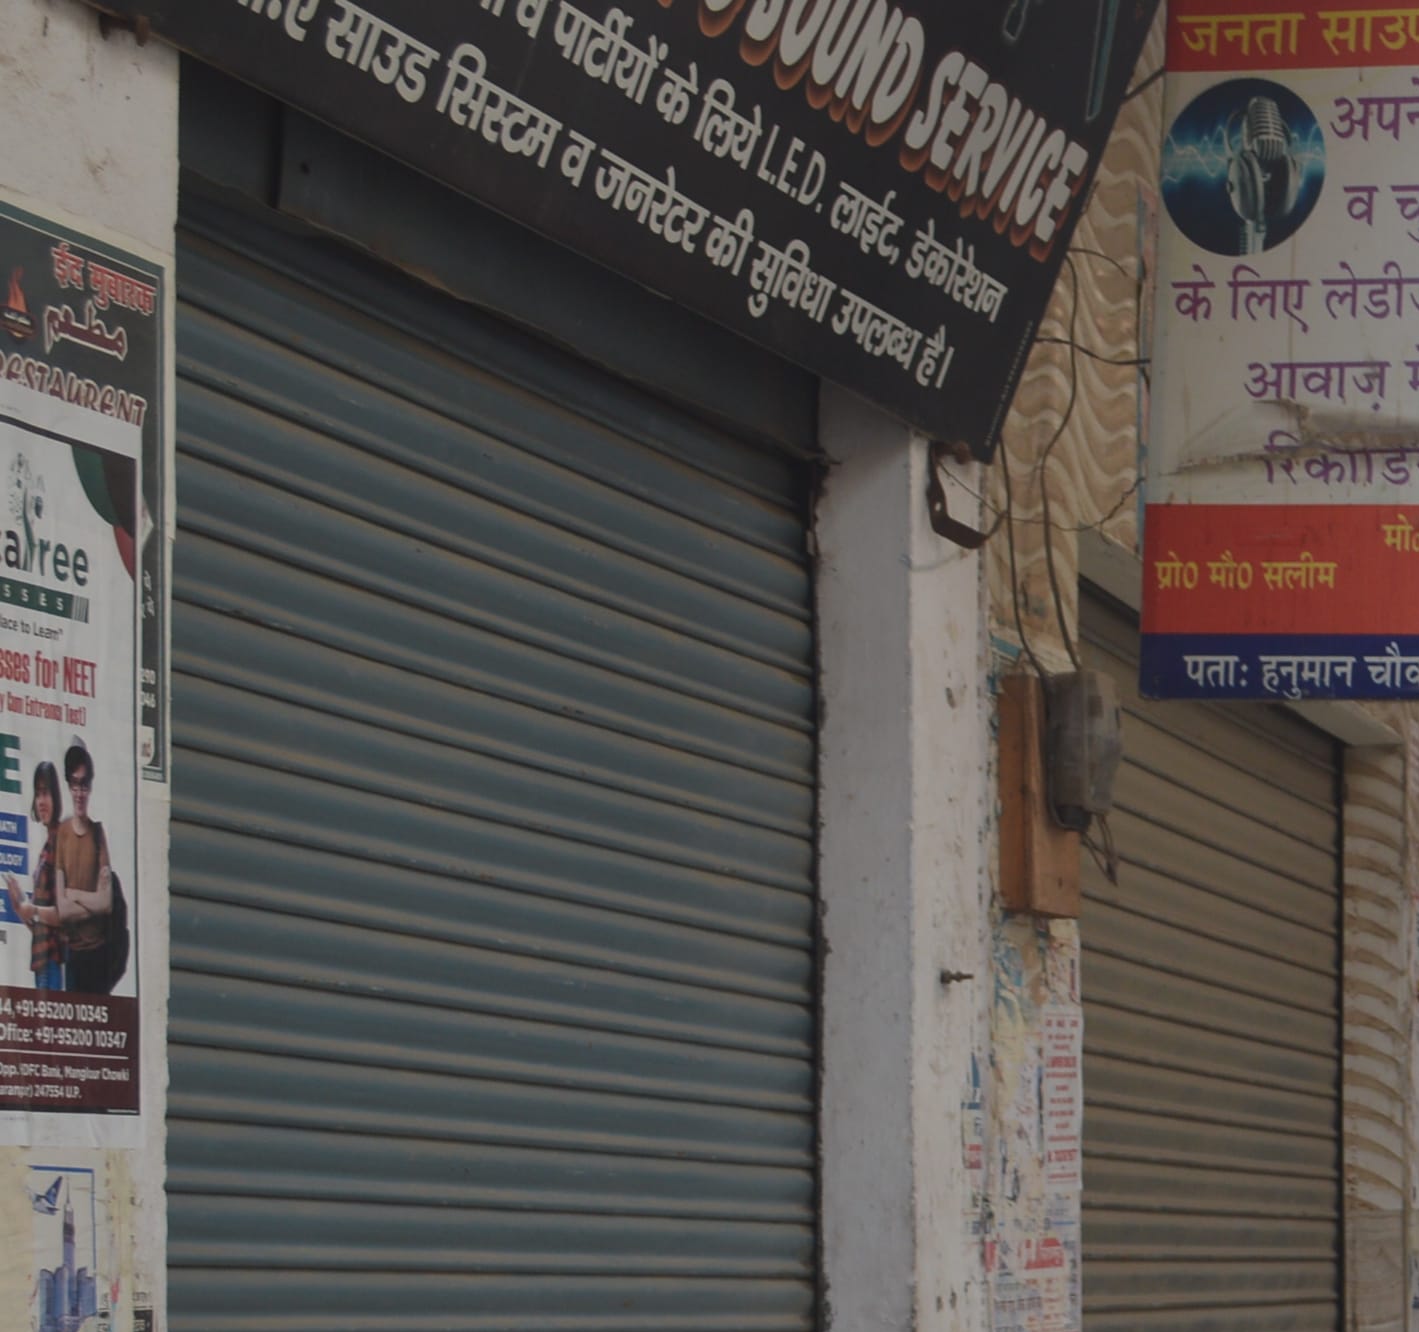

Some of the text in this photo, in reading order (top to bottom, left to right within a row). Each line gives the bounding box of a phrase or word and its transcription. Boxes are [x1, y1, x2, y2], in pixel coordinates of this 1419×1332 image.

[1177, 12, 1306, 57] जनता
[904, 50, 1090, 262] SERVICE
[435, 42, 563, 169] सिस्टम
[559, 129, 597, 188] व
[594, 148, 710, 254] जनरेटर
[703, 208, 755, 277] की
[746, 238, 837, 318] सुविधा
[830, 288, 923, 371] उपलब्ध
[655, 61, 699, 125] के
[693, 77, 763, 169] लिये
[756, 123, 827, 215] L.E.D.
[904, 217, 1009, 324] डेकोरेशन
[1343, 185, 1379, 226] व
[51, 242, 157, 316] ईद मुबारक
[1171, 263, 1216, 322] के
[1227, 264, 1311, 334] लिए
[1244, 360, 1391, 412] आवाज़
[1262, 551, 1338, 590] सलीम
[35, 650, 59, 690] for
[63, 655, 97, 699] NEET
[1183, 655, 1249, 689] पता:
[1259, 654, 1357, 698] हनुमान
[75, 1003, 109, 1024] 10345
[94, 1029, 128, 1049] 10347
